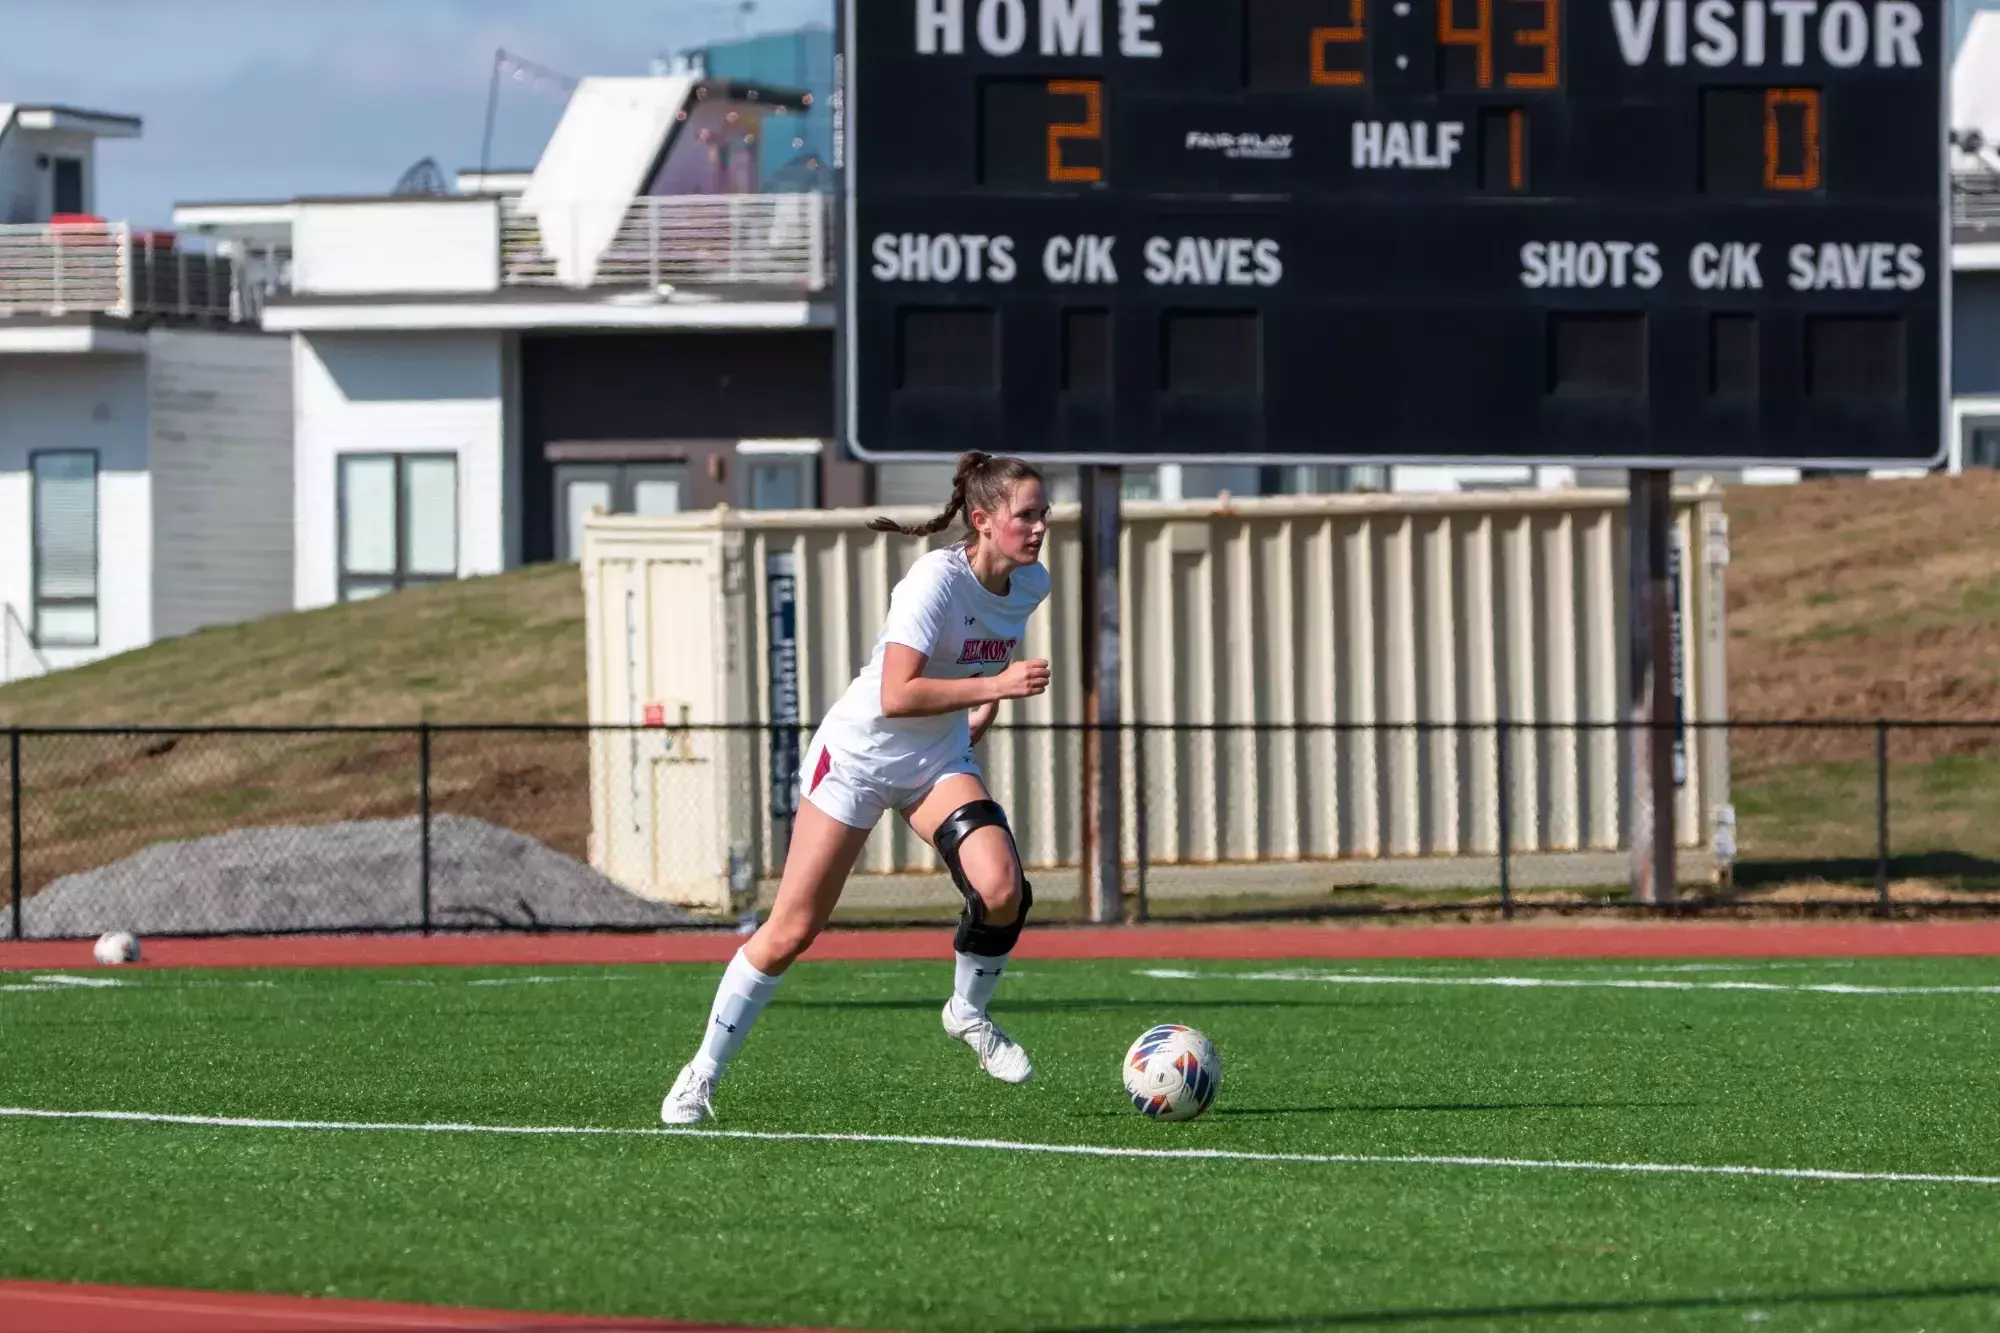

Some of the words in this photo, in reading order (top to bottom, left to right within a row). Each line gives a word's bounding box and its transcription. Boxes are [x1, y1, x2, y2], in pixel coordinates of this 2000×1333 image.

[914, 0, 1163, 58] HOME
[1610, 0, 1924, 68] VISITOR
[1047, 80, 1101, 181] 2
[1351, 121, 1464, 169] HALF
[1509, 108, 1523, 190] 1
[1764, 88, 1819, 190] 0
[872, 233, 1017, 283] SHOTS
[1042, 234, 1118, 283] C/K
[1144, 236, 1283, 286] SAVES
[1519, 241, 1663, 288] SHOTS
[1688, 241, 1763, 289] C/K
[1788, 242, 1926, 290] SAVES
[962, 637, 1017, 662] BELMONT
